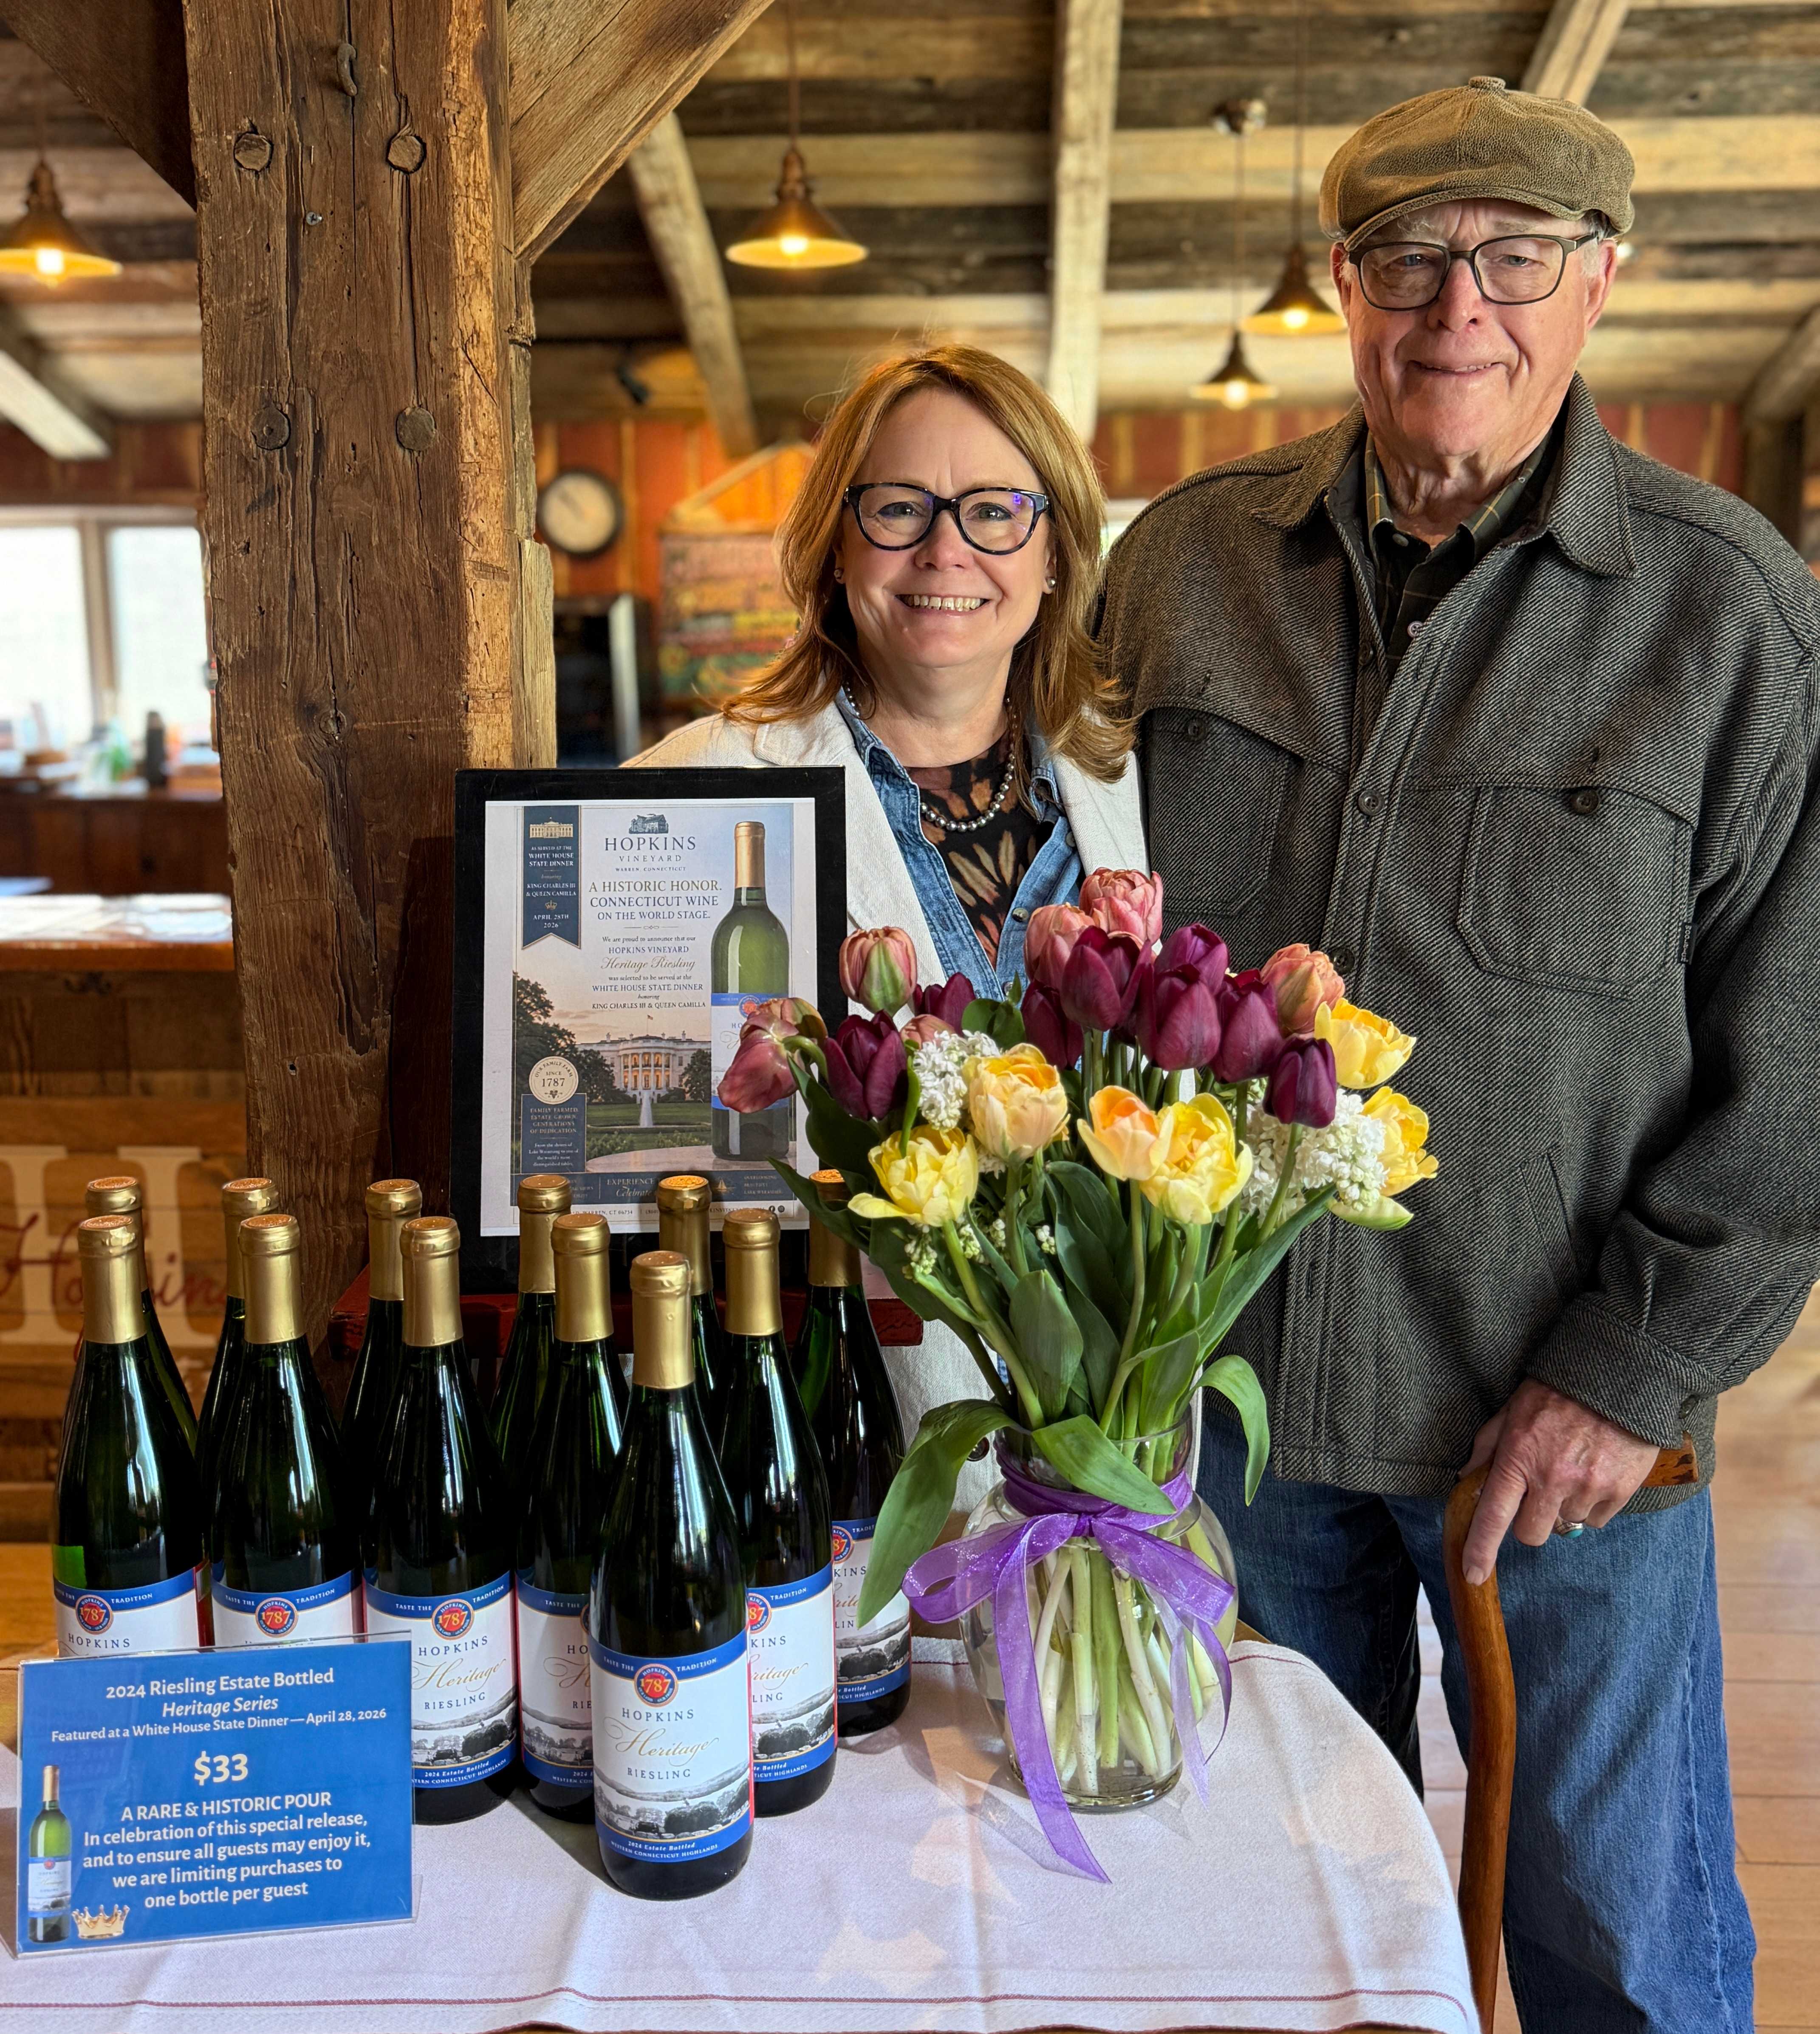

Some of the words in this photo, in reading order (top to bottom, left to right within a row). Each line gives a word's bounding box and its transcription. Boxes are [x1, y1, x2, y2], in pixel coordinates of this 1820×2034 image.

[605, 836, 696, 851] HOPKINS
[589, 881, 598, 893] A
[602, 881, 666, 892] HISTORIC
[671, 880, 722, 892] HONOR.
[590, 896, 682, 907] CONNECTICUT
[686, 896, 718, 906] WINE
[598, 912, 612, 920] ON
[615, 912, 636, 920] THE
[639, 911, 675, 919] WORLD
[678, 910, 710, 919] STAGE.
[601, 957, 648, 973] Heritage
[651, 955, 696, 972] Riesling
[542, 1078, 565, 1087] 1787
[111, 1593, 153, 1604] TRADITION
[296, 1588, 335, 1604] TRADITION
[472, 1585, 504, 1603] TRADITION
[770, 1587, 807, 1600] TRADITION
[79, 1607, 106, 1622] 1787
[261, 1610, 291, 1626] 1787
[438, 1611, 469, 1629] 1787
[68, 1633, 130, 1649] HOPKINS
[418, 1636, 488, 1656] HOPKINS
[642, 1668, 668, 1677] HOPKINS
[676, 1658, 717, 1672] TRADITION
[106, 1684, 146, 1698] 2024
[150, 1677, 217, 1696] Riesling
[220, 1675, 270, 1691] Estate
[274, 1667, 334, 1687] Bottled
[411, 1658, 506, 1693] Heritage
[640, 1678, 671, 1693] 1787
[162, 1699, 231, 1718] Heritage
[233, 1695, 279, 1712] Series
[424, 1692, 485, 1709] RIESLING
[622, 1708, 694, 1722] HOPKINS
[51, 1727, 106, 1742] Featured
[108, 1728, 120, 1738] at
[122, 1729, 130, 1737] a
[132, 1723, 170, 1736] White
[173, 1723, 211, 1734] House
[213, 1719, 245, 1731] State
[338, 1711, 356, 1723] 28,
[358, 1708, 387, 1720] 2026
[602, 1716, 720, 1767] Heritage
[194, 1751, 248, 1786] $33
[432, 1774, 475, 1784] CONNECTICUT
[478, 1758, 506, 1777] HIGHLANDS
[466, 1760, 489, 1772] Bottled
[627, 1767, 691, 1780] RIESLING
[121, 1806, 133, 1822] A
[137, 1802, 182, 1820] RARE
[185, 1802, 199, 1816] &
[202, 1795, 282, 1815] HISTORIC
[285, 1791, 332, 1809] POUR
[84, 1831, 100, 1846] In
[103, 1825, 193, 1845] celebration
[197, 1821, 215, 1838] of
[217, 1819, 246, 1836] this
[249, 1814, 303, 1836] special
[307, 1812, 367, 1828] release,
[83, 1850, 114, 1868] and
[117, 1852, 133, 1865] to
[136, 1849, 191, 1863] ensure
[194, 1842, 214, 1859] all
[217, 1842, 268, 1861] guests
[271, 1839, 306, 1855] may
[308, 1833, 352, 1852] enjoy
[355, 1831, 370, 1848] it,
[634, 1850, 679, 1859] CONNECTICUT
[681, 1844, 718, 1856] HIGHLANDS
[669, 1842, 695, 1851] Bottled
[112, 1875, 137, 1888] we
[140, 1872, 167, 1886] are
[171, 1864, 237, 1883] limiting
[240, 1859, 322, 1881] purchases
[325, 1857, 342, 1870] to
[144, 1895, 176, 1908] one
[179, 1886, 229, 1906] bottle
[232, 1887, 260, 1905] per
[263, 1882, 308, 1902] guest
